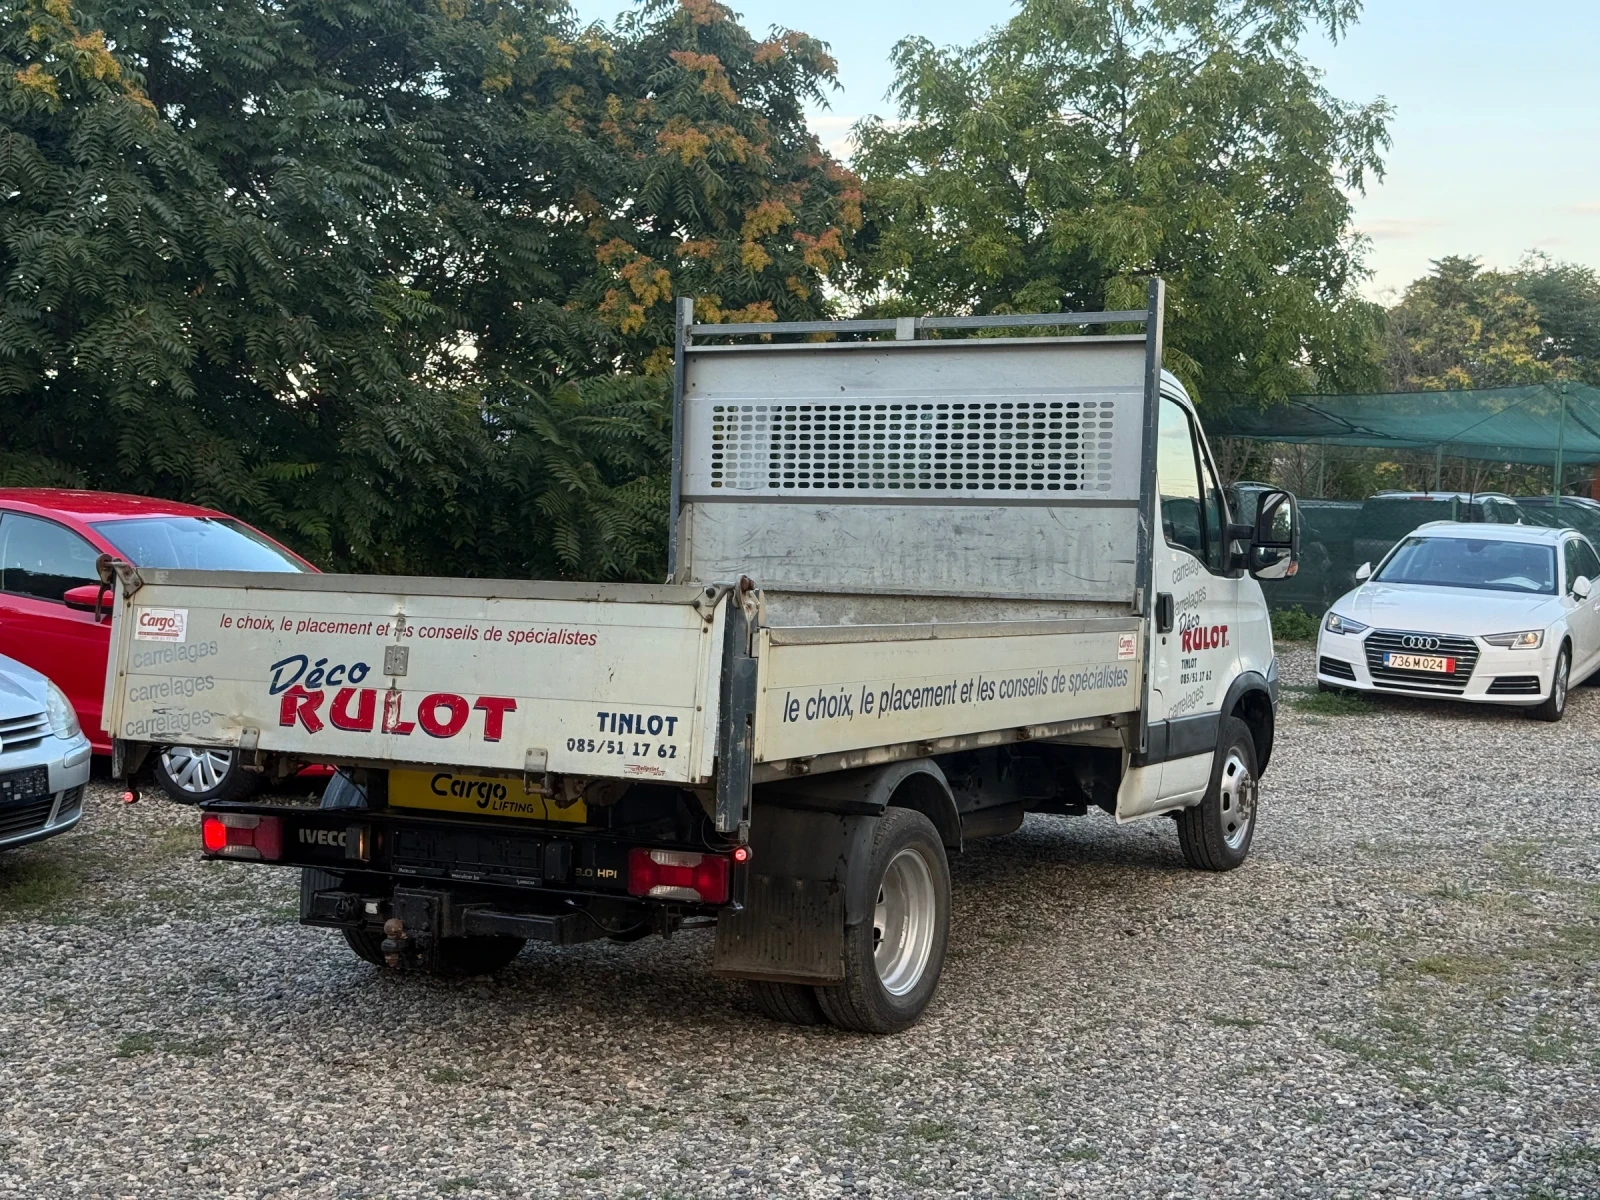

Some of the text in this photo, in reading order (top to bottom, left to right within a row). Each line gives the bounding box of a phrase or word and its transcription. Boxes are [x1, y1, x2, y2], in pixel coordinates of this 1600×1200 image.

[1175, 585, 1207, 616] arrelages
[140, 612, 175, 631] Cargo
[219, 613, 233, 628] le
[236, 614, 275, 632] choix,
[279, 616, 293, 631] le
[296, 618, 373, 636] placement
[376, 622, 391, 636] et
[418, 624, 479, 641] conseils
[483, 625, 502, 642] de
[506, 628, 598, 646] spécialistes
[1181, 625, 1228, 654] RULOT
[133, 640, 219, 669] carrelages
[1391, 655, 1443, 670] 736 M 024
[129, 675, 215, 703] carrelages
[269, 654, 371, 696] Déco
[783, 665, 1129, 722] le choix, le placement et les conseils de spécialistes
[125, 709, 212, 737] carrelages
[279, 685, 518, 742] RULOT
[597, 712, 679, 736] TINLOT
[566, 738, 677, 759] 085/51 17 62
[430, 773, 507, 809] Cargo
[492, 801, 534, 813] LIFTING
[597, 868, 618, 879] HPI
